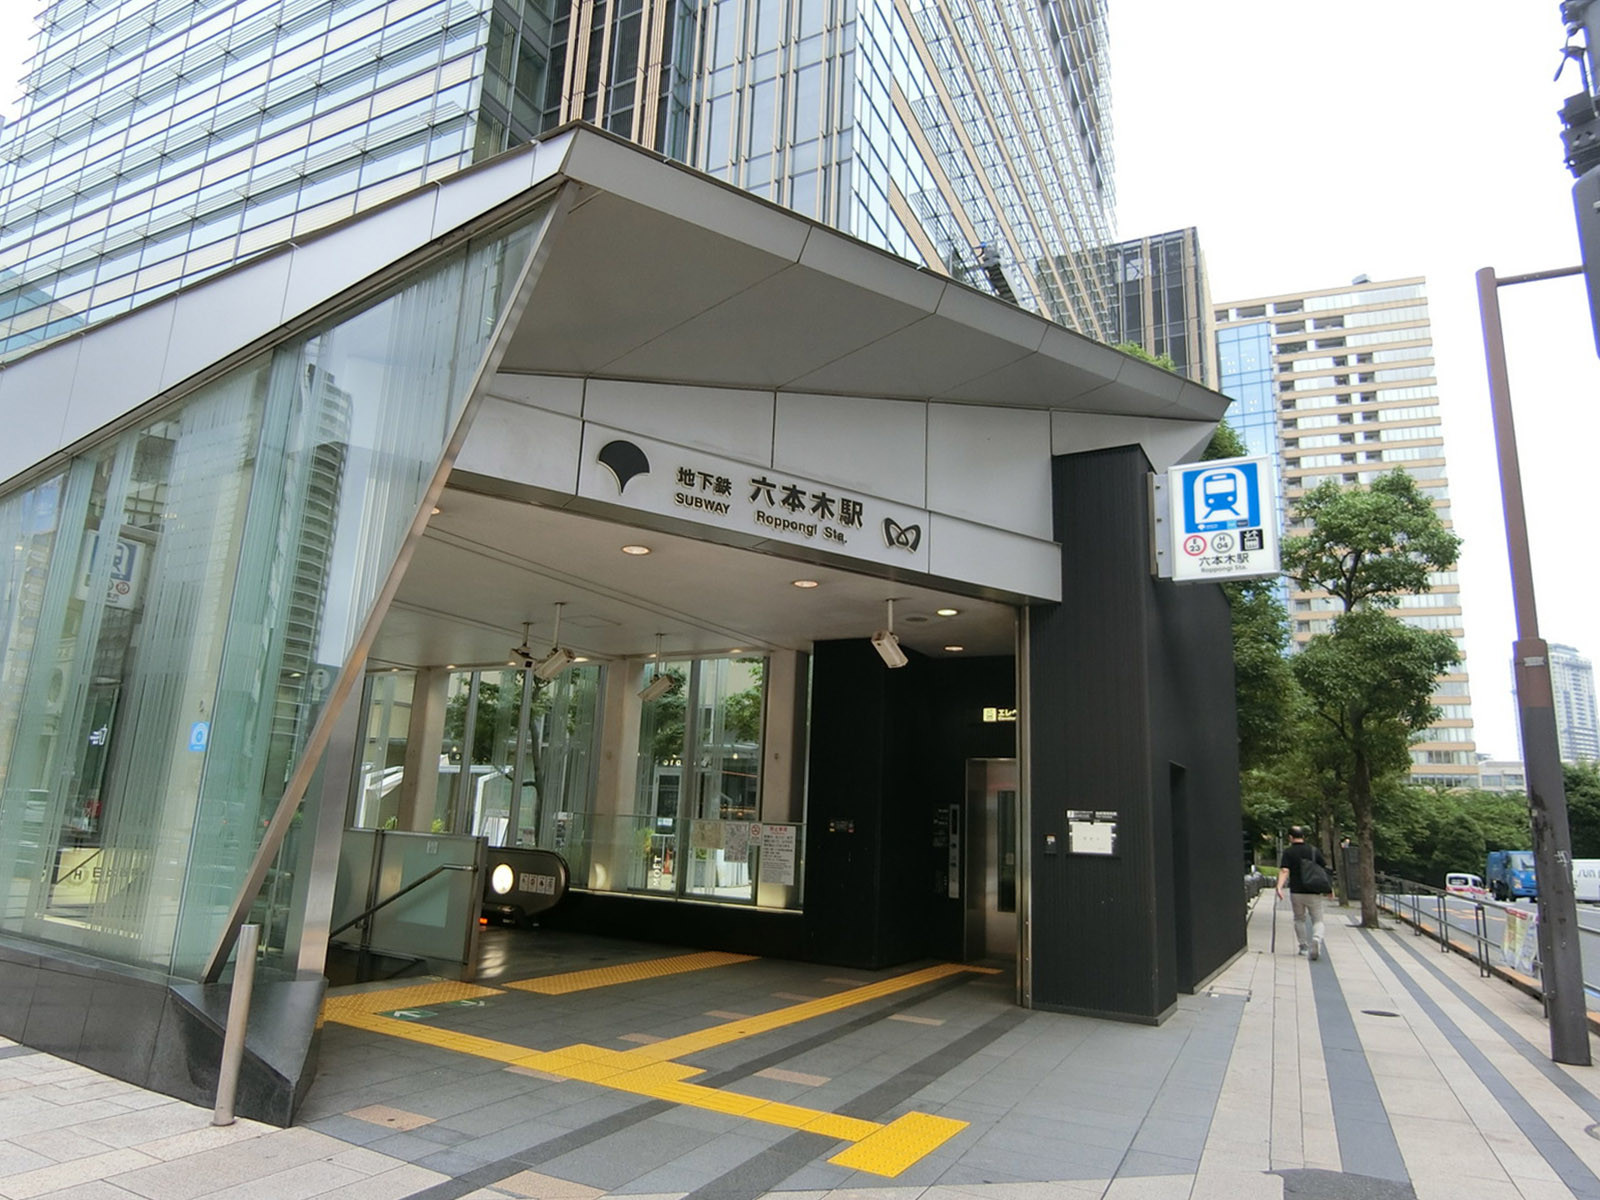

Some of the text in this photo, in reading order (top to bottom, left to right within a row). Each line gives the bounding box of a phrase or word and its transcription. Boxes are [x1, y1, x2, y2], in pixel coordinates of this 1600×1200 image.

[675, 492, 731, 515] SUBWAY
[677, 466, 864, 529] 地下鉄 六本木駅
[756, 509, 848, 544] Roppongi Sta.
[1199, 552, 1249, 567] 六本木駅
